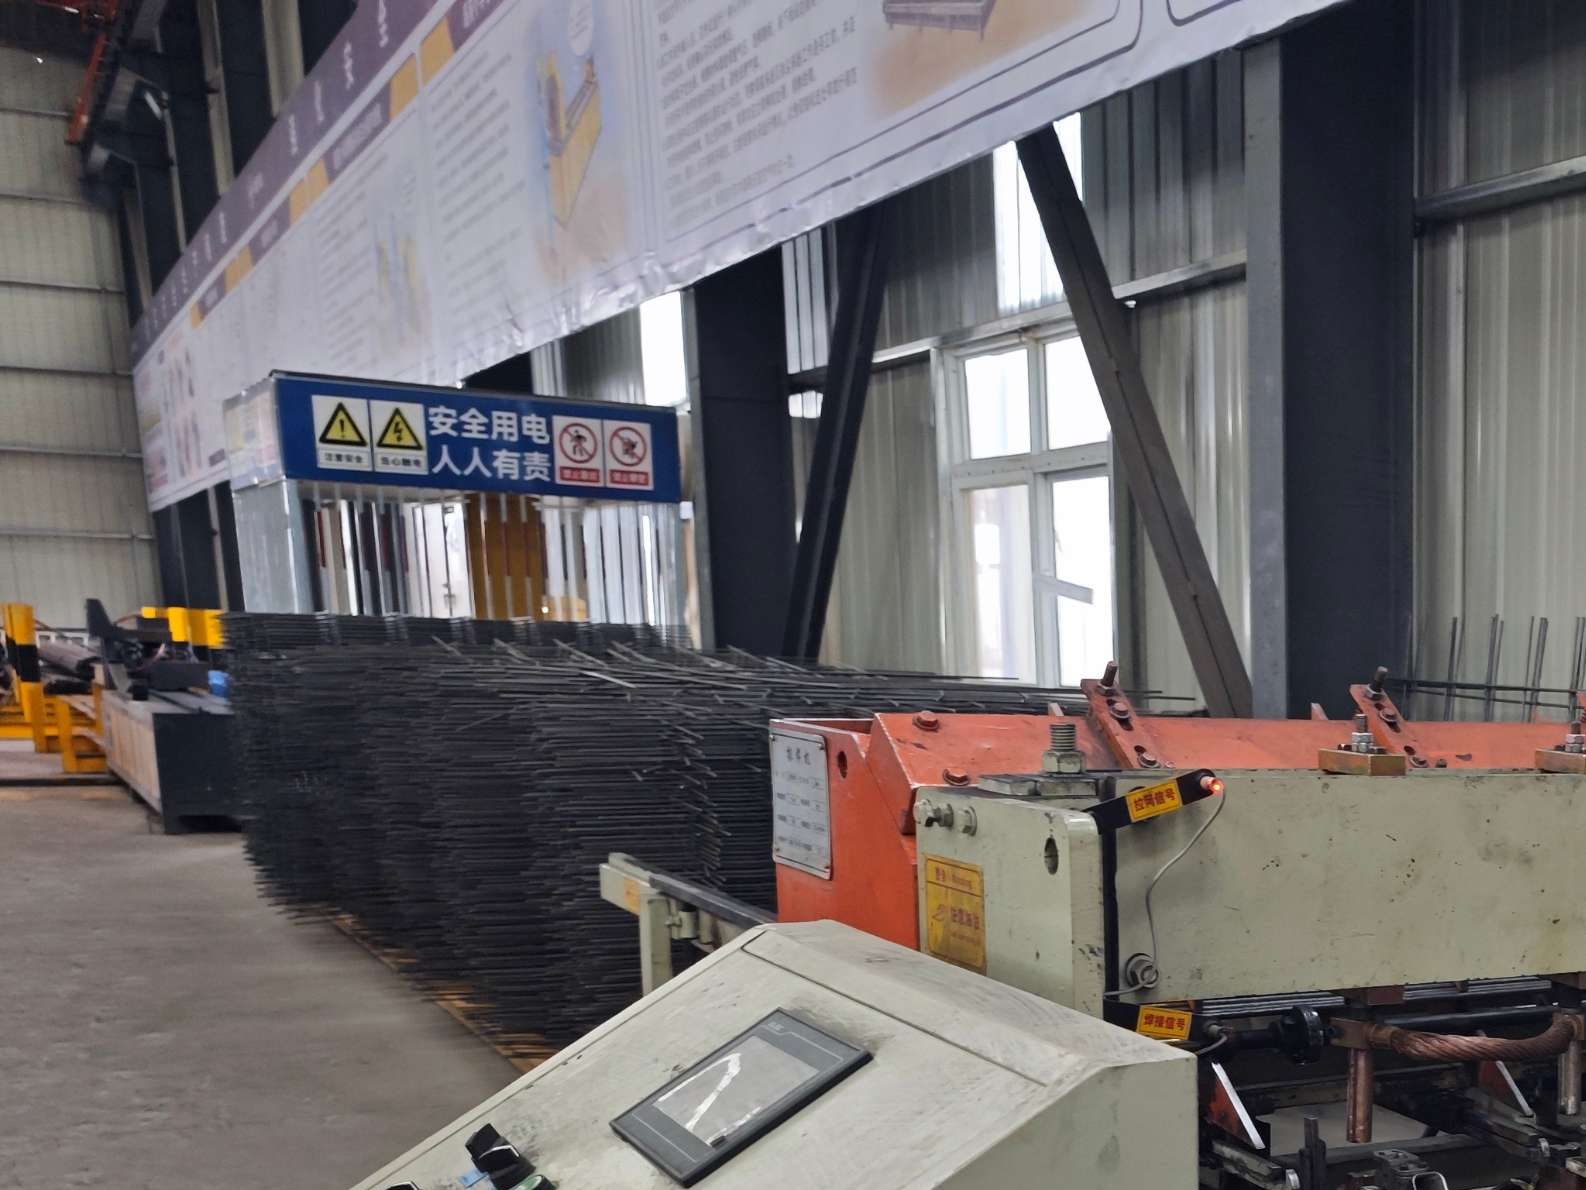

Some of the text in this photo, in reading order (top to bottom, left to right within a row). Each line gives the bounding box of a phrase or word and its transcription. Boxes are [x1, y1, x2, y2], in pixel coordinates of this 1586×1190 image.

[428, 406, 550, 444] 安全用电
[432, 444, 551, 481] 人人有责
